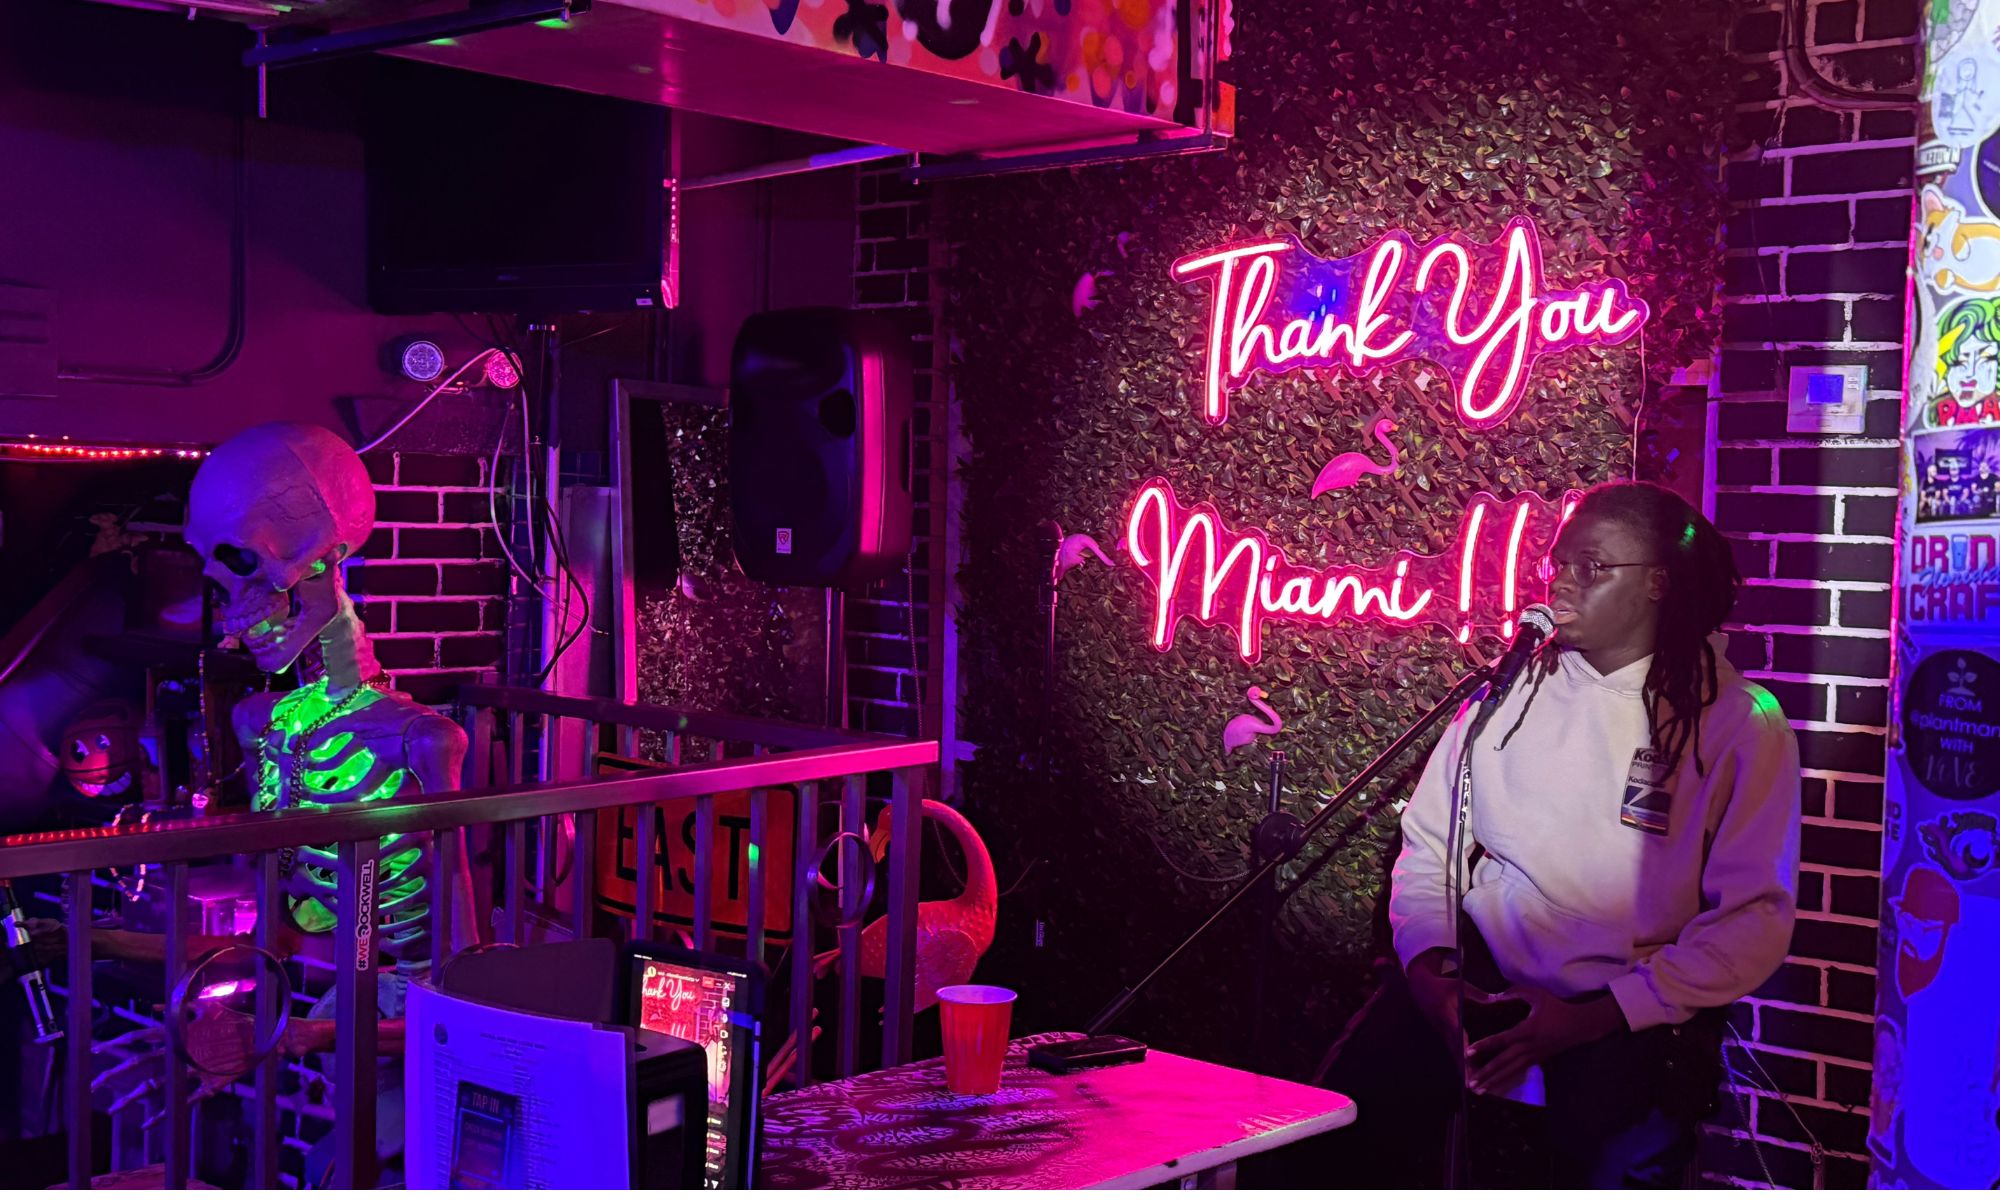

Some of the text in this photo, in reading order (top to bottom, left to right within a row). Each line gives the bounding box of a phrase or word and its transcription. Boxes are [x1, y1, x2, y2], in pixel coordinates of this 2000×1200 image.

[1173, 223, 1640, 420] Thank You
[1128, 486, 1433, 658] Miami
[1938, 694, 1983, 713] FROM
[1940, 737, 1975, 754] WITH
[1922, 754, 1980, 789] LOVE
[617, 805, 757, 901] EAST
[666, 979, 695, 1011] You
[471, 1091, 489, 1110] TAP
